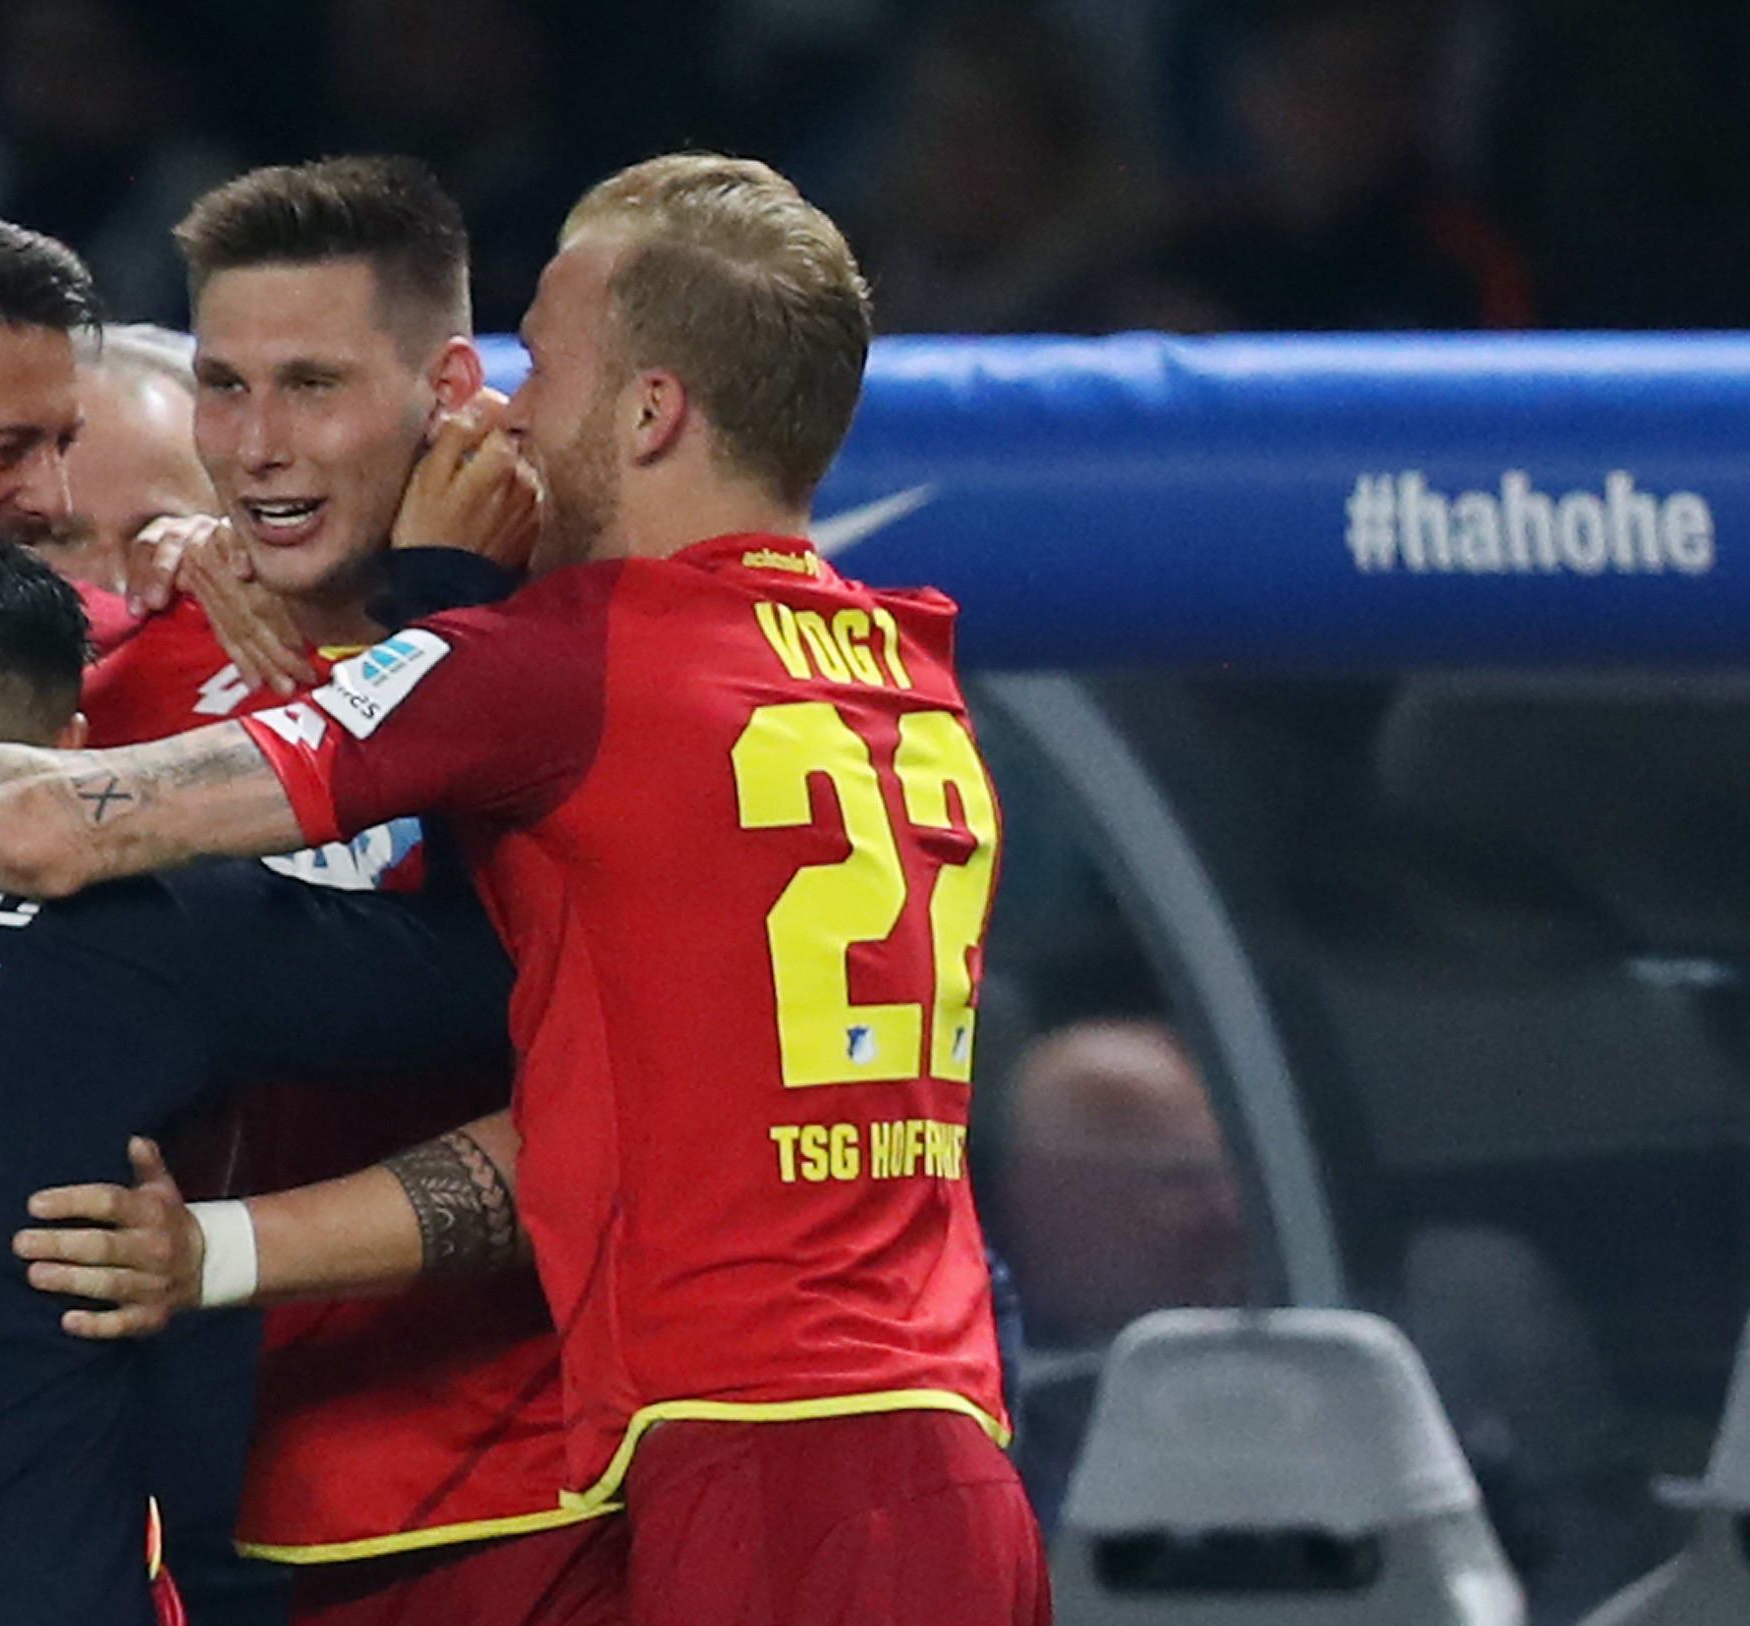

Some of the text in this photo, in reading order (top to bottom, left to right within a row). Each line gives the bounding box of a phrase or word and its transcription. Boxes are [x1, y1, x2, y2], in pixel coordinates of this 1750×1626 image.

[1345, 470, 1715, 575] #hahohe
[730, 701, 999, 1088] 22
[770, 1124, 859, 1182] TSG
